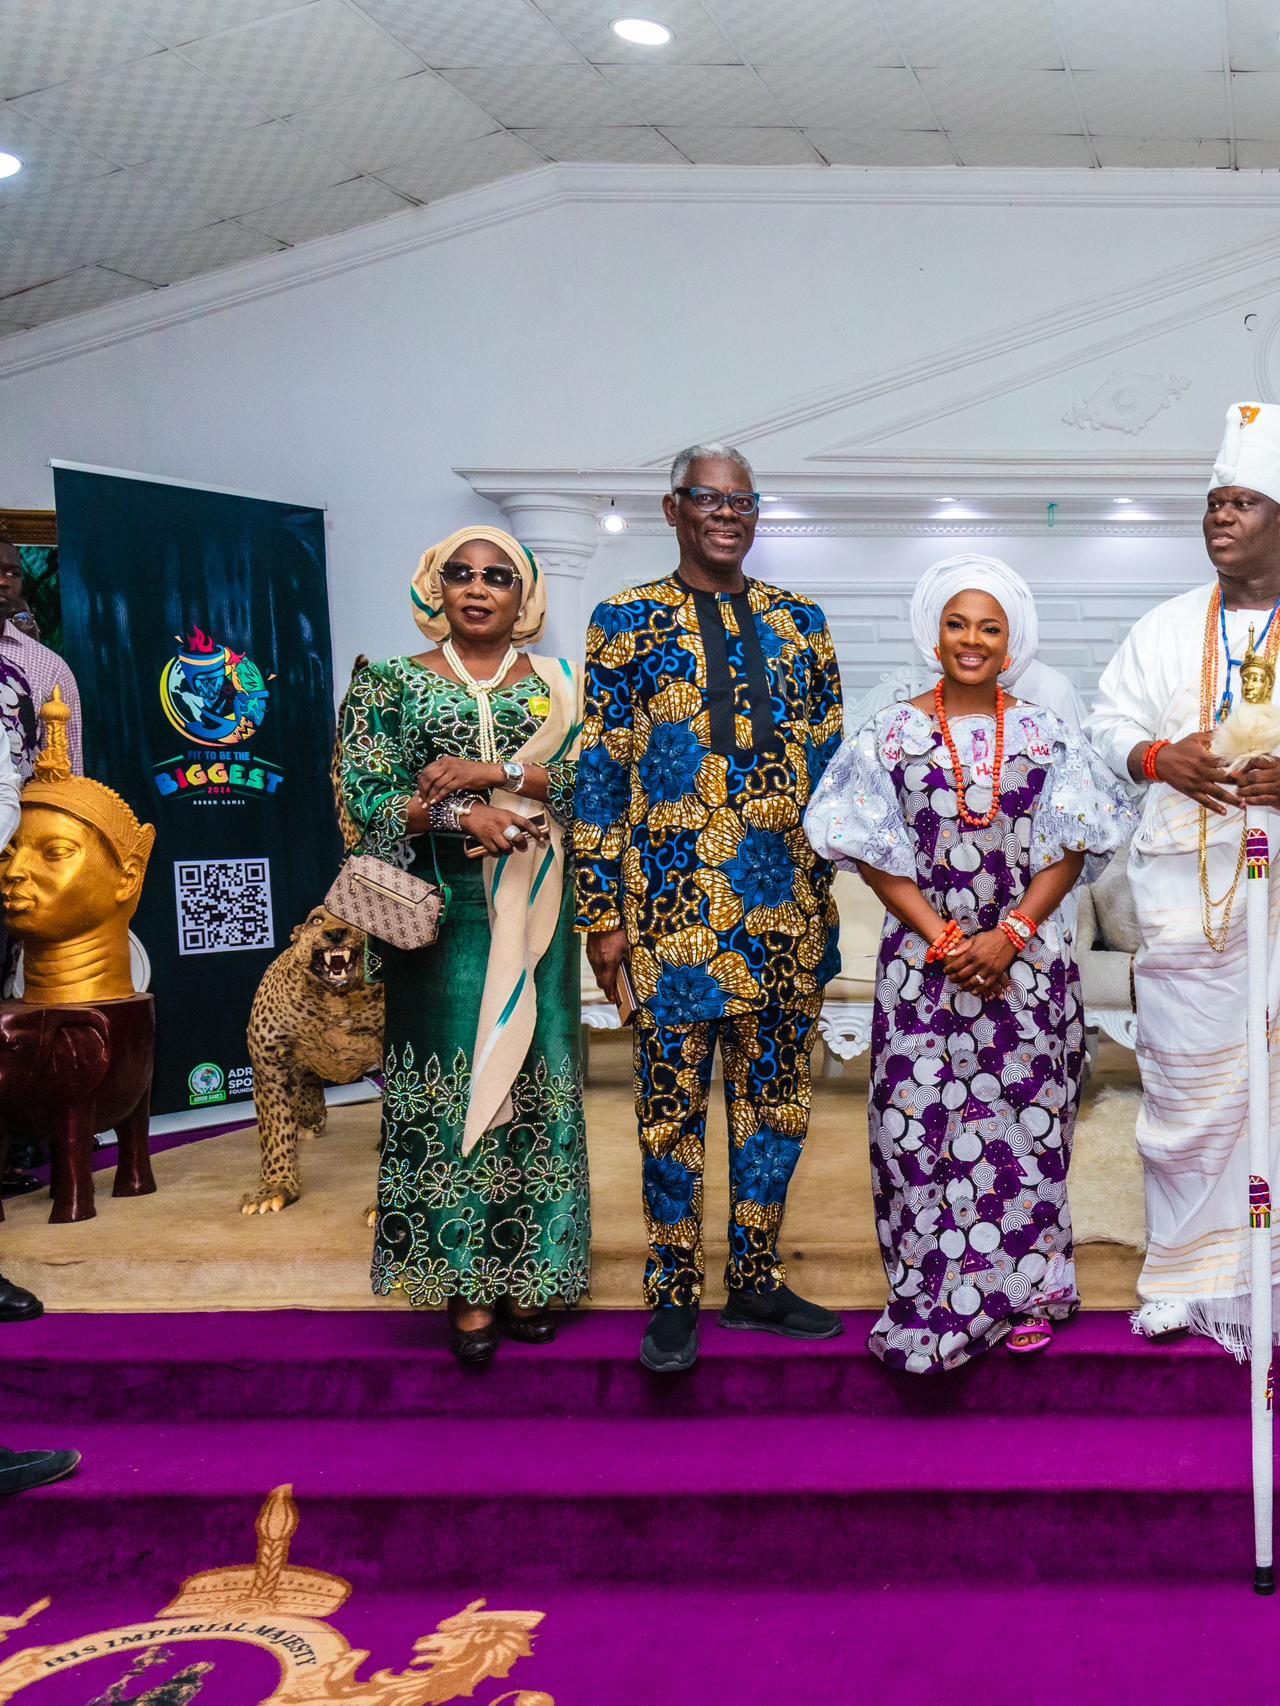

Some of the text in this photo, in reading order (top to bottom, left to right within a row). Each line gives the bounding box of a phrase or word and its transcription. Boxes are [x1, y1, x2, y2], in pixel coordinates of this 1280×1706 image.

[187, 751, 250, 761] FIT TO BE THE
[155, 763, 283, 795] BIGGEST
[228, 1077, 255, 1089] SPO
[43, 1621, 318, 1668] HIS IMPERIAL MAJESTY
